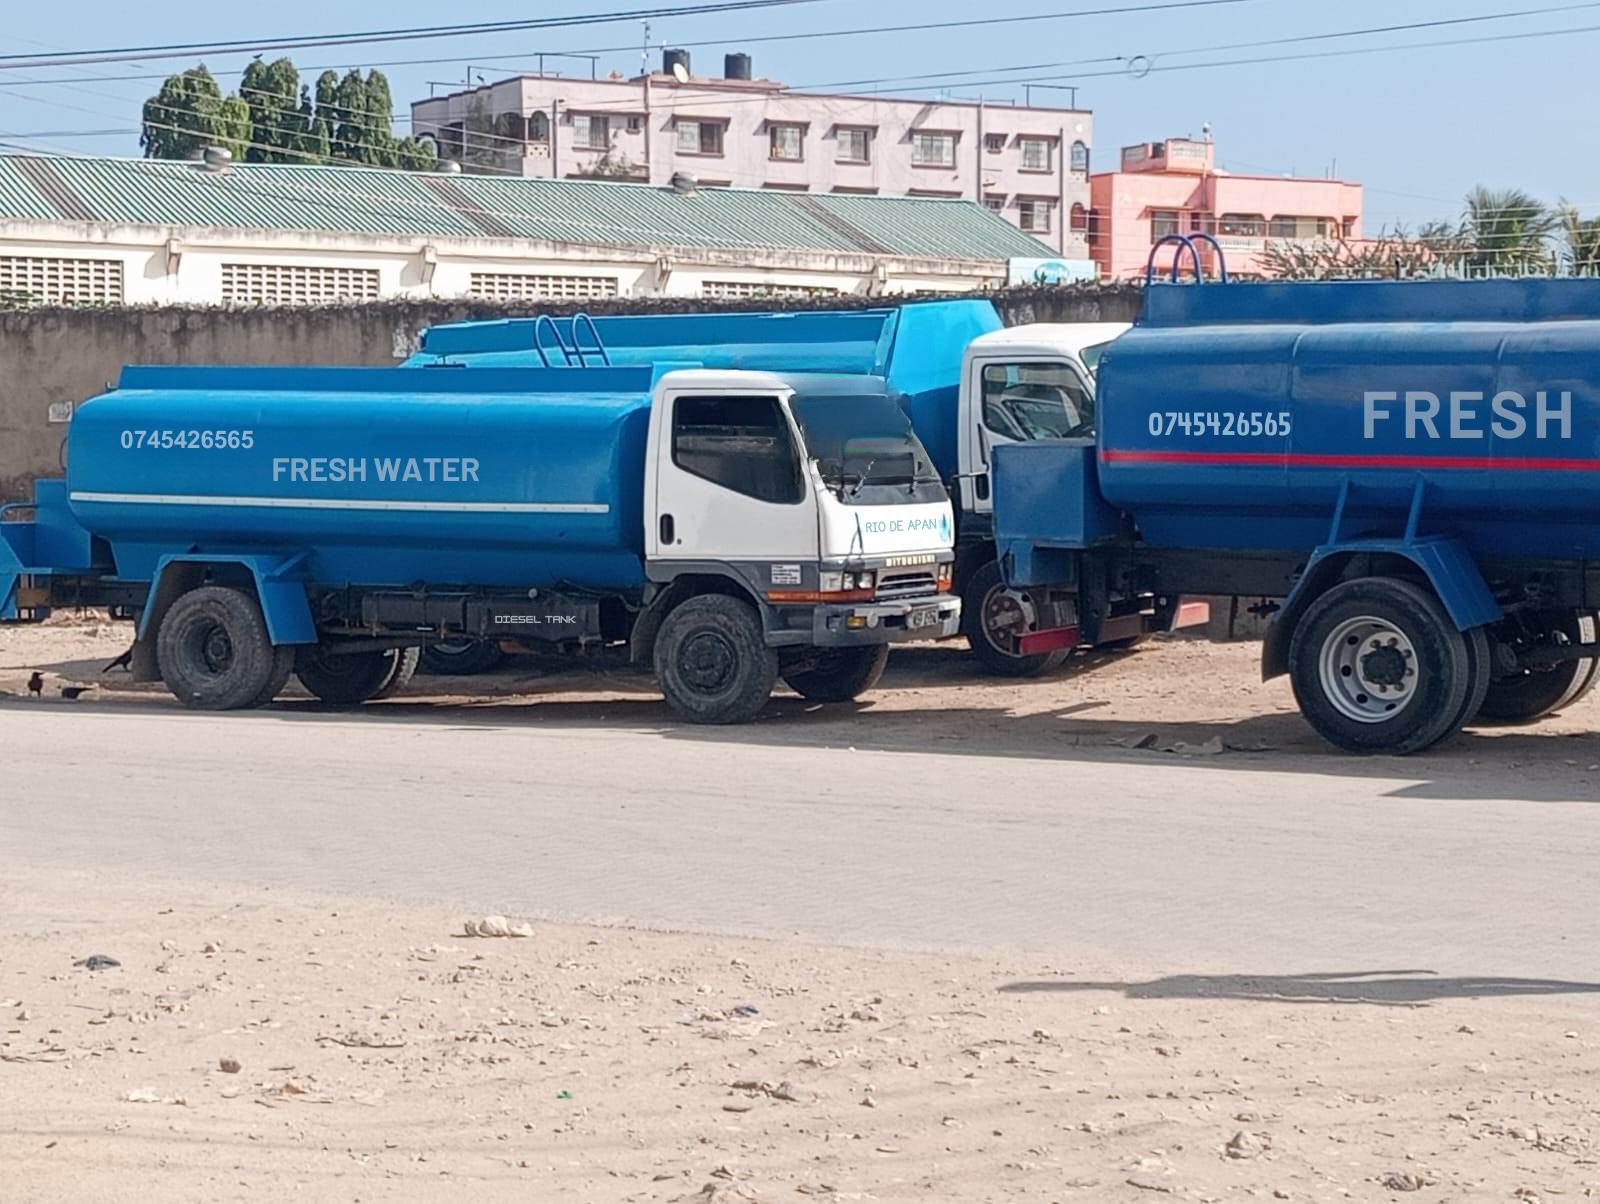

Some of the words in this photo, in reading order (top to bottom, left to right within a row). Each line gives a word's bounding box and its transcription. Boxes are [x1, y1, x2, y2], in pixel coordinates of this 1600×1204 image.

[1148, 412, 1292, 437] 0745426565
[1363, 391, 1572, 440] FRESH
[120, 430, 254, 449] 0745426565
[272, 457, 367, 482] FRESH
[374, 457, 480, 482] WATER
[865, 521, 886, 533] RIO
[890, 520, 903, 531] DE
[907, 519, 937, 531] APAN
